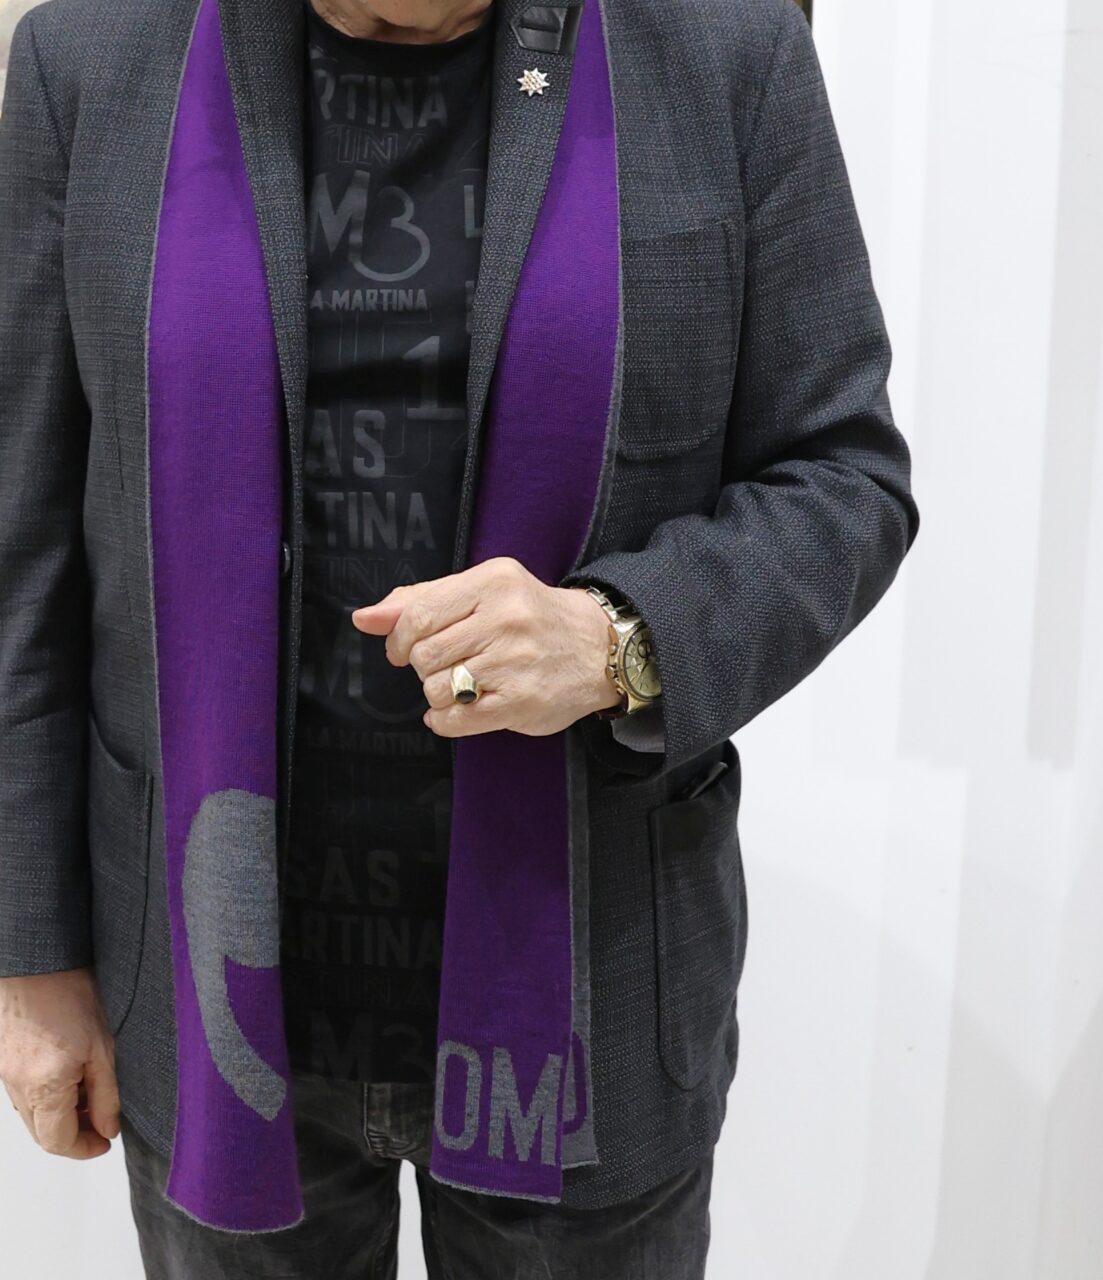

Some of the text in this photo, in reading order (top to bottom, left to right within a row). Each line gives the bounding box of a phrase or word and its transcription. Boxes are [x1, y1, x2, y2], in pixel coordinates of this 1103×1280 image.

[331, 288, 428, 312] MARTINA
[308, 491, 436, 551] TINA
[338, 728, 437, 756] MARTINA
